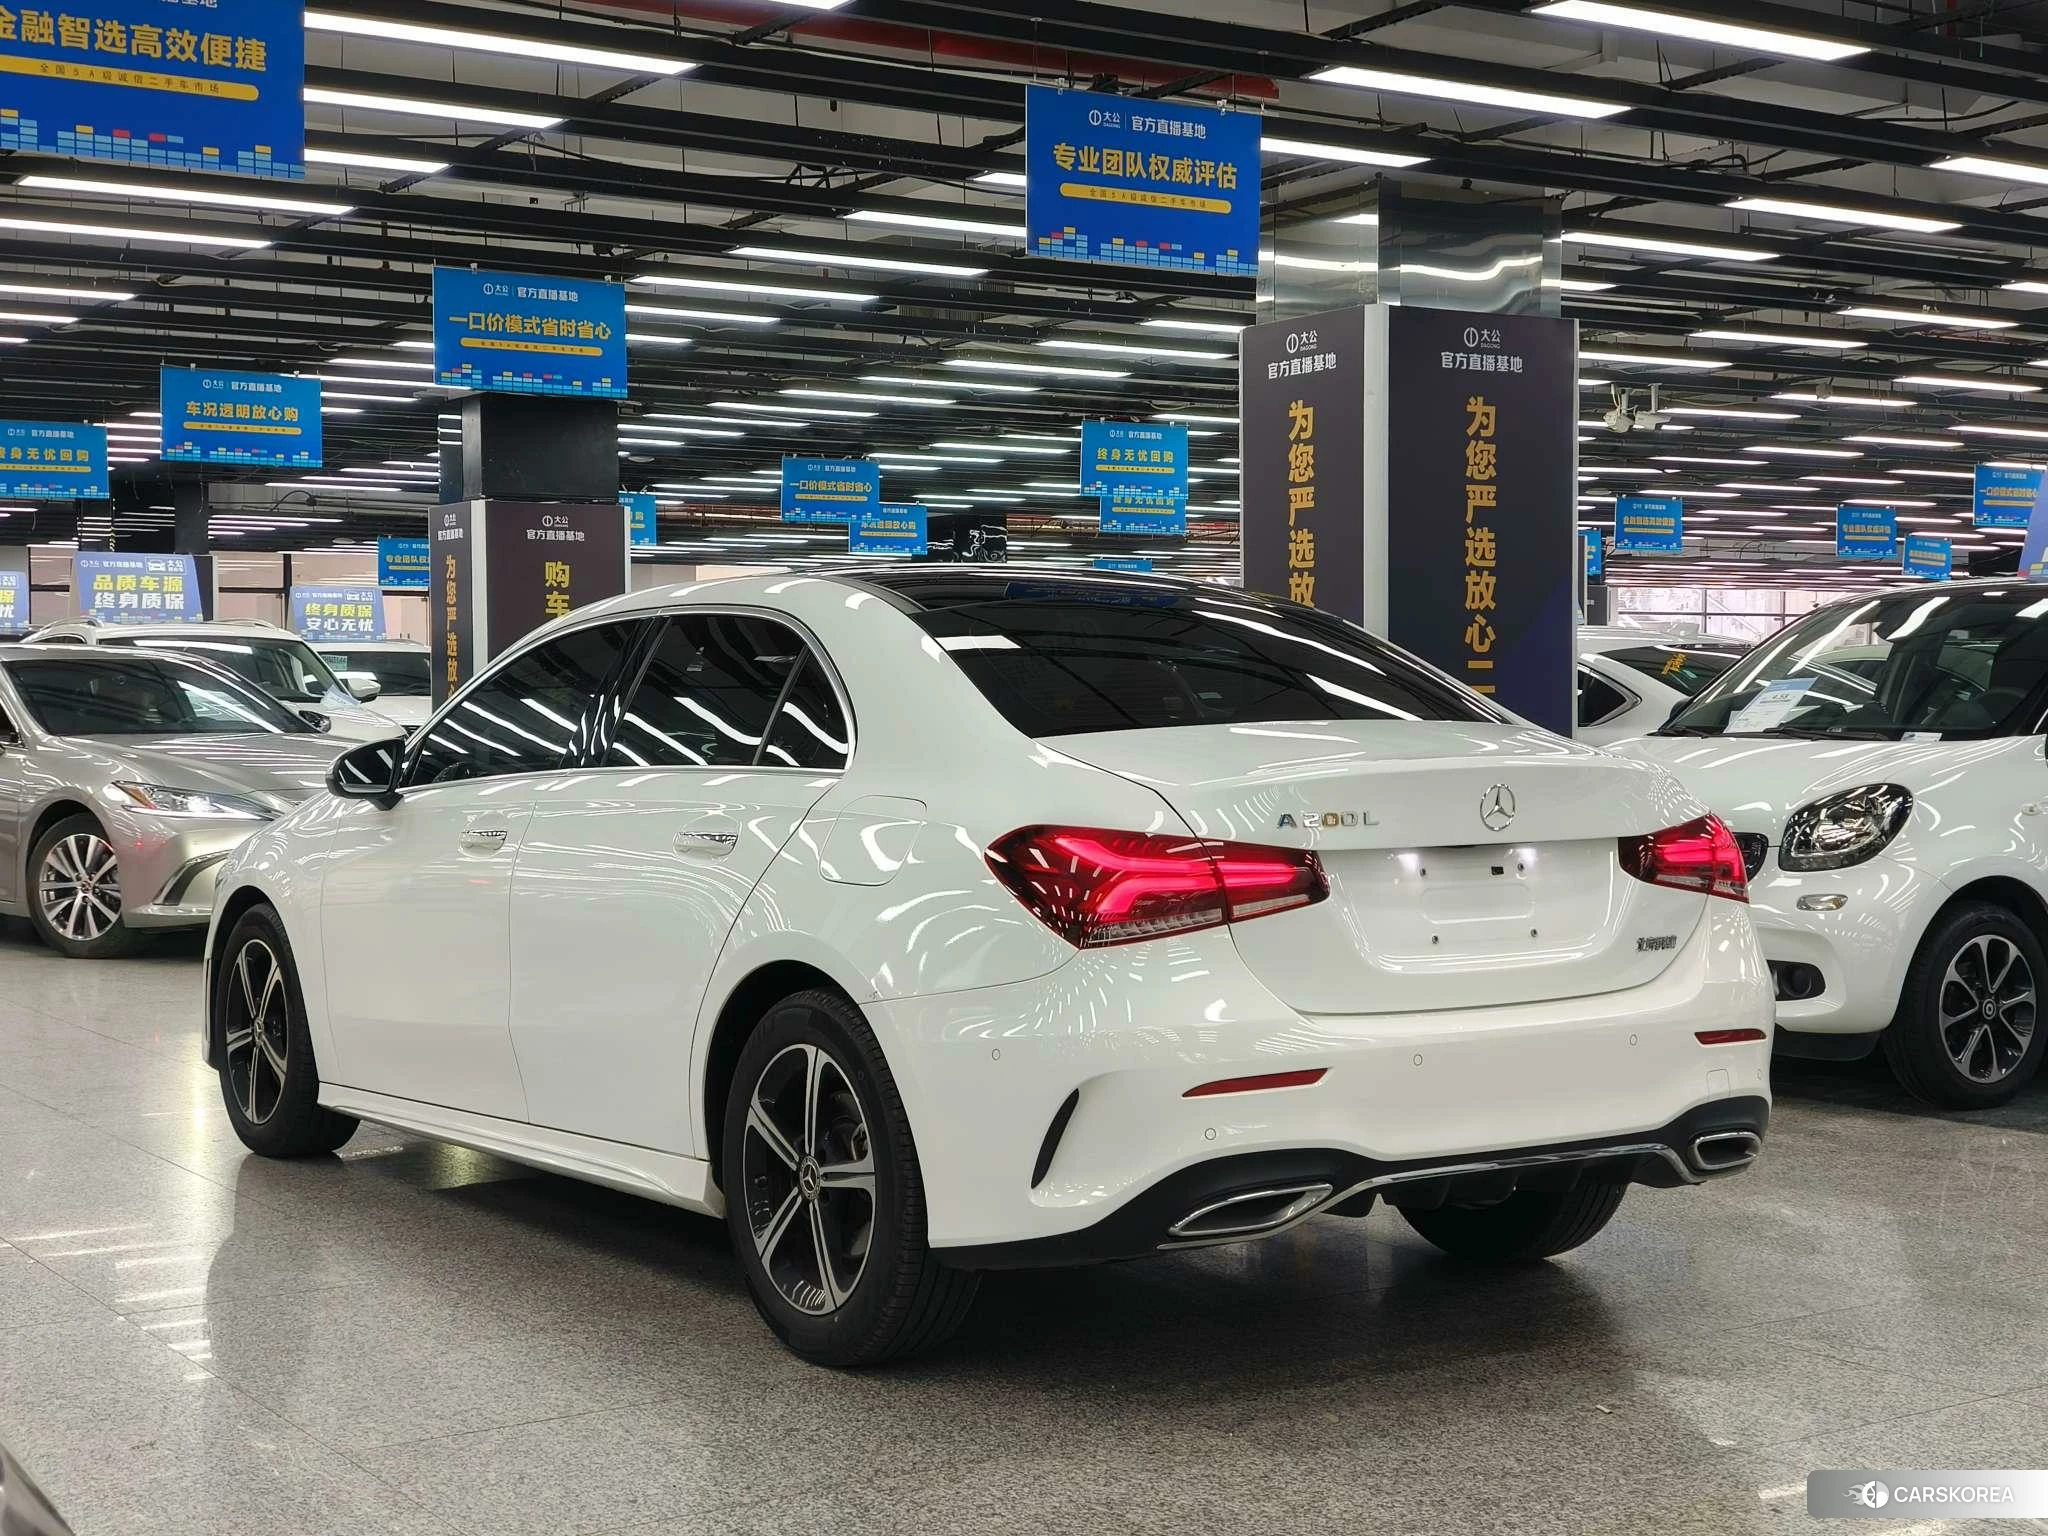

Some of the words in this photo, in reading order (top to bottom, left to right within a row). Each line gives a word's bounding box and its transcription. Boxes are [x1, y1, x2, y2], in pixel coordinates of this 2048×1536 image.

[1103, 112, 1121, 123] 大公
[1132, 115, 1207, 139] 官方直播基地
[1053, 143, 1237, 189] 专业团队权威评估
[517, 286, 578, 302] 官方直播基地
[449, 312, 612, 340] 一口价模式省时省心
[1481, 328, 1501, 342] 大公
[1300, 330, 1318, 344] 大公
[1267, 352, 1337, 379] 官方直播基地
[1440, 351, 1523, 373] 官方直播基地
[186, 401, 298, 421] 车况透明放心购
[1097, 447, 1174, 463] 终身无忧回购
[1288, 399, 1316, 608] 为您严选放
[554, 515, 568, 524] 大公
[526, 529, 585, 541] 官方直播基地
[1465, 396, 1497, 693] 为您严选放心二
[93, 574, 183, 592] 品质车源
[544, 561, 570, 618] 购车
[94, 592, 184, 610] 终身质保
[305, 603, 373, 618] 终身质保
[306, 617, 374, 632] 安心无忧
